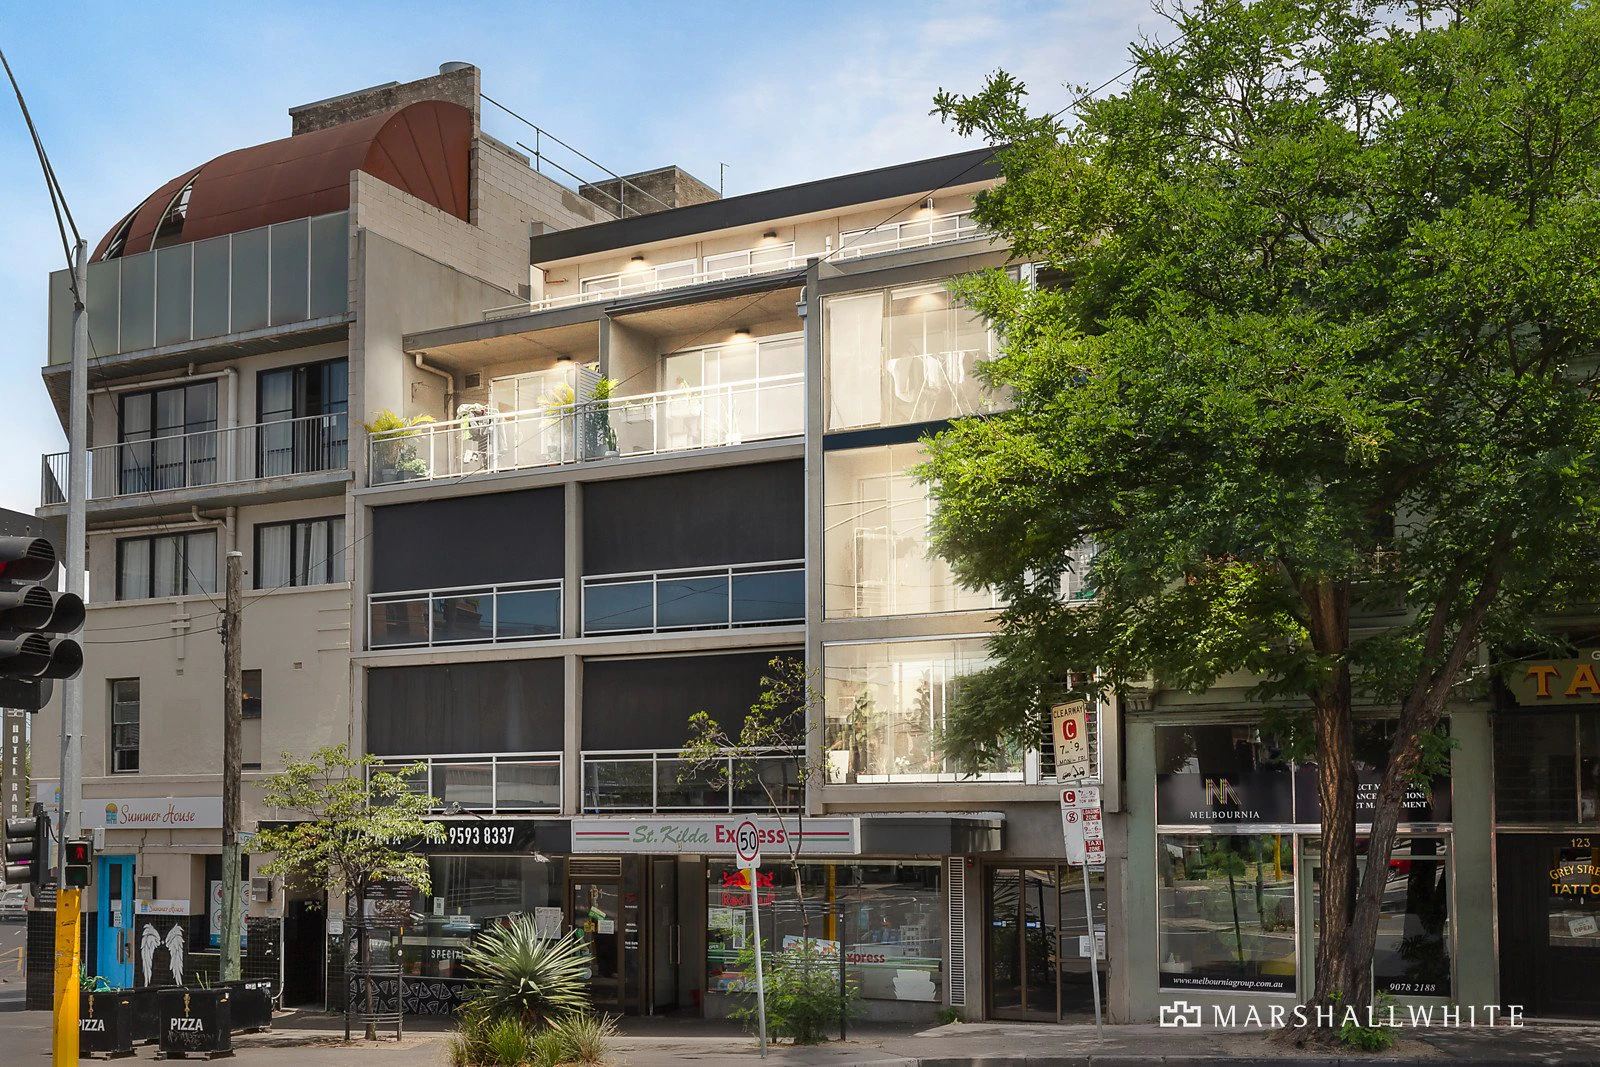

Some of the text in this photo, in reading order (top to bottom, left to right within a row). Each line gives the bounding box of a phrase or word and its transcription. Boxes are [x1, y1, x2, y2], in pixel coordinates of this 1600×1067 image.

[1053, 706, 1082, 718] CLEARWAY
[120, 803, 195, 824] Summer House
[1190, 811, 1260, 819] MELBOURNIA
[450, 827, 480, 844] 9593
[484, 827, 515, 844] 8337
[715, 825, 785, 843] Exess
[740, 831, 757, 850] 50
[1571, 838, 1590, 847] 123
[1550, 865, 1574, 880] GREY
[1173, 977, 1283, 989] www.melbourniagroup.com.au
[1414, 983, 1436, 991] 2188
[170, 1018, 203, 1031] PIZZA
